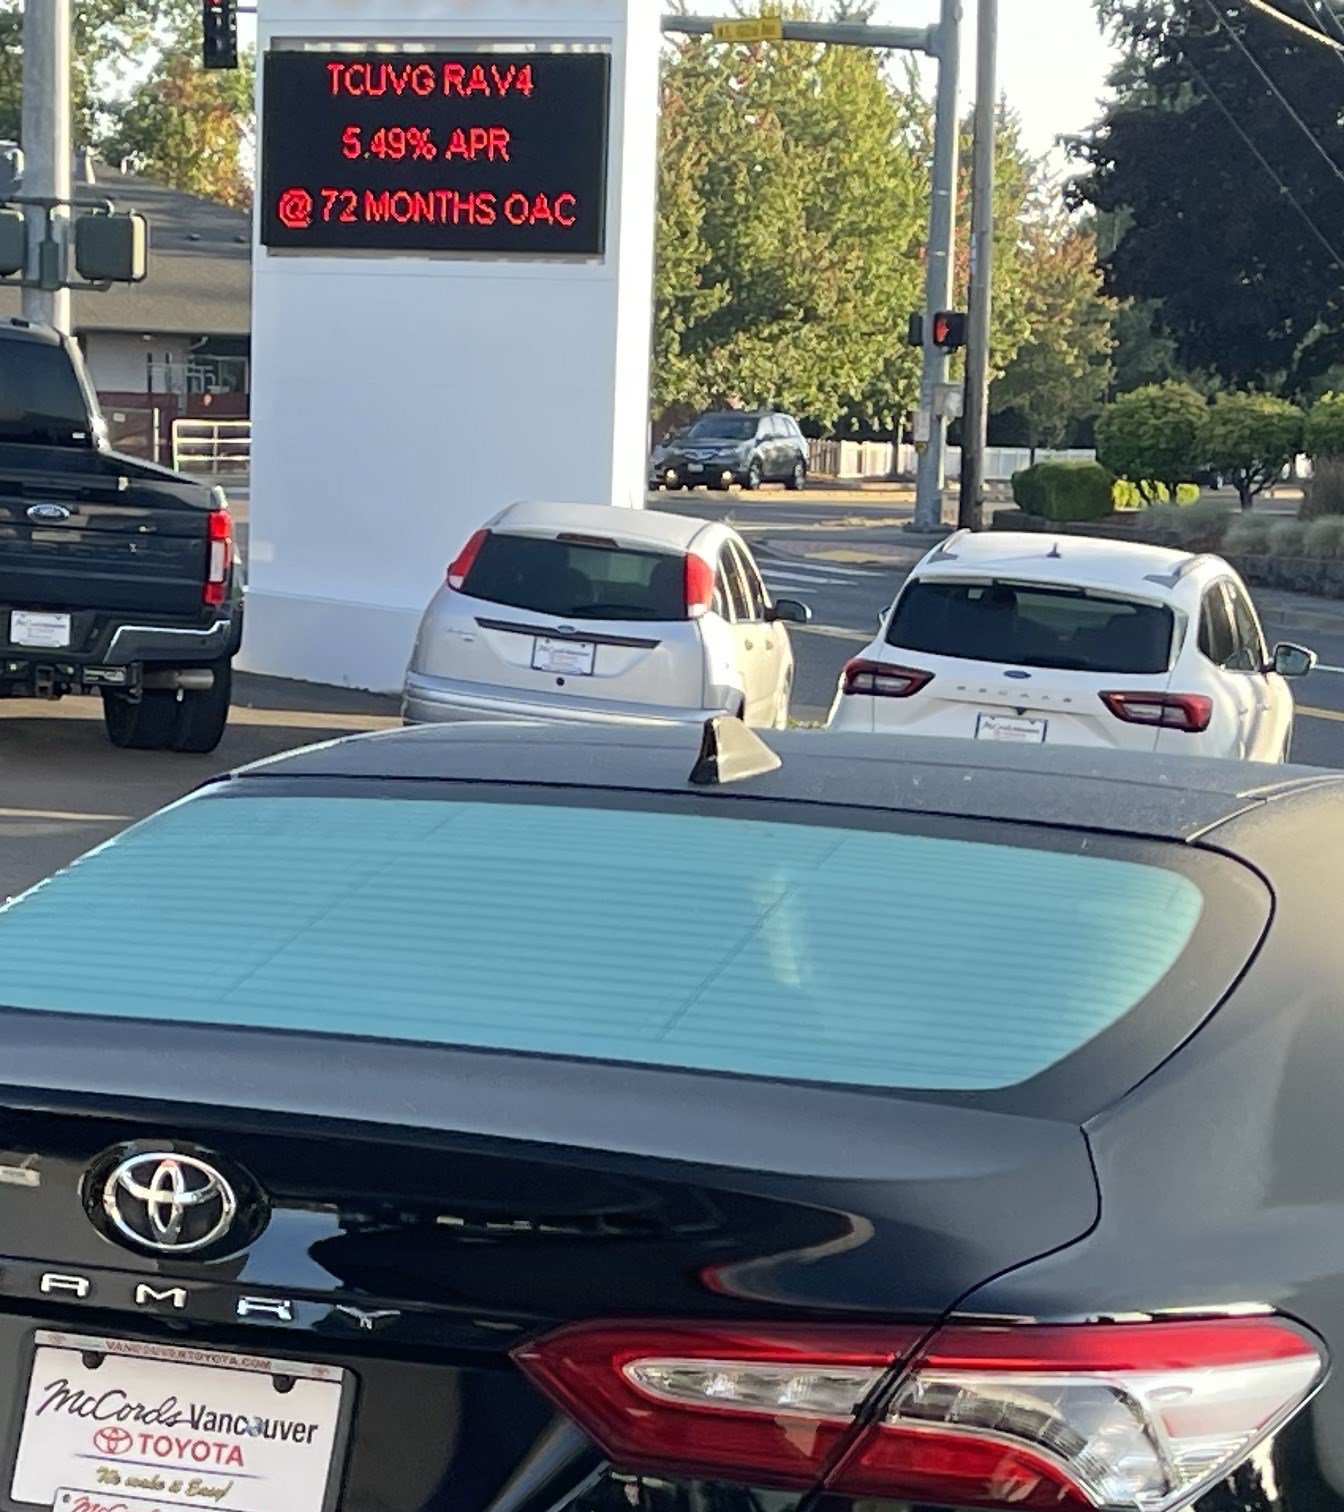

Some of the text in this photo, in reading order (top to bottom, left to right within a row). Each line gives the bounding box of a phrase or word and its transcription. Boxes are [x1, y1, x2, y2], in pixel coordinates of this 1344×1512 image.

[325, 61, 534, 98] TCUVG RAV4
[341, 123, 511, 162] 5.49% APR
[277, 186, 577, 229] @ 72 MONTHS OAC
[138, 1432, 244, 1467] TOYOTA
